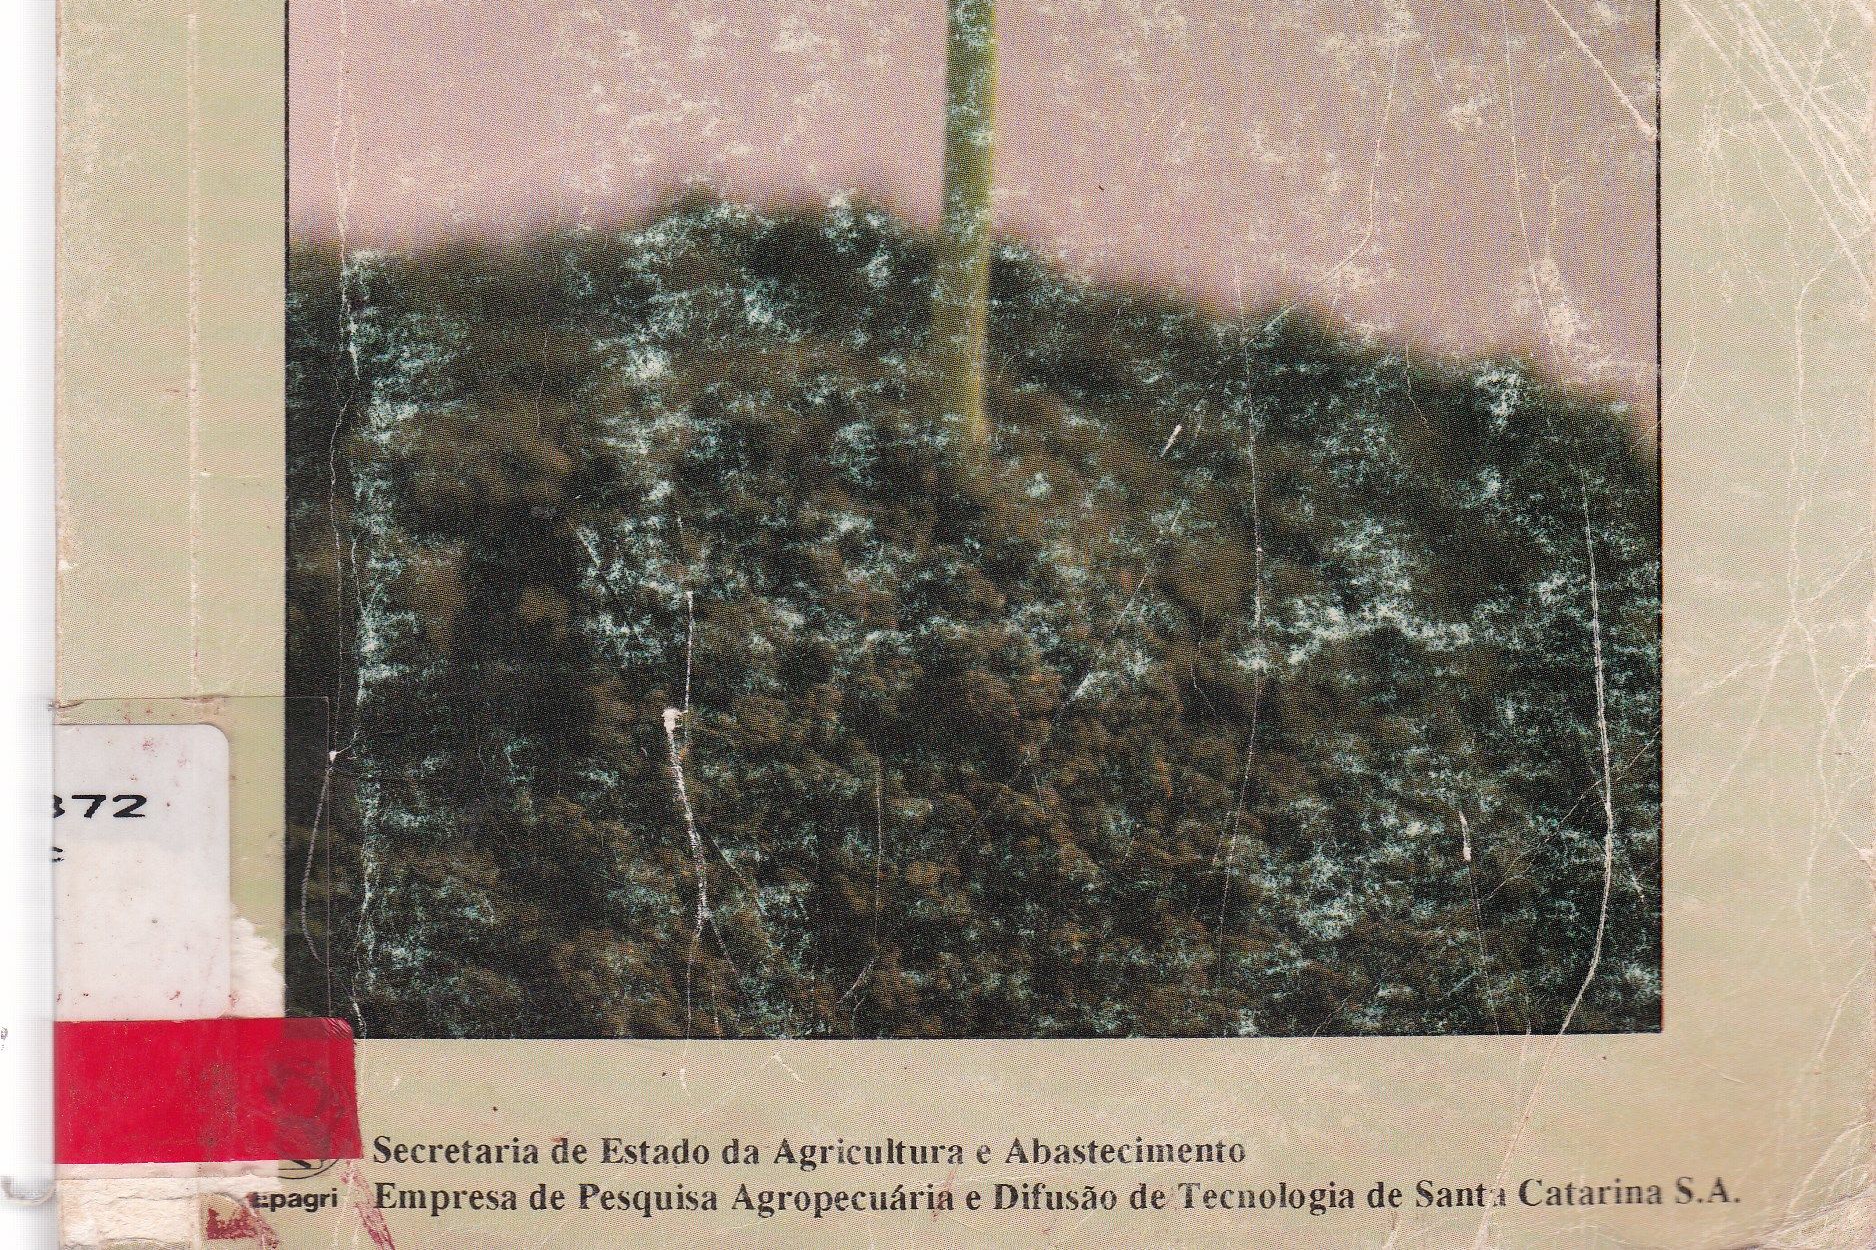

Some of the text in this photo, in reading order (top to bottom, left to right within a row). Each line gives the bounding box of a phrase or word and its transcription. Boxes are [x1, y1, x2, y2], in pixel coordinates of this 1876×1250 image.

[373, 1134, 1247, 1172] Secretaria de Estado da Agricultura e Abastecimento
[374, 1181, 518, 1217] Empresa
[529, 1182, 566, 1211] de
[577, 1183, 718, 1218] Pesquisa
[731, 1182, 953, 1219] Agropecuária
[965, 1189, 982, 1211] e
[993, 1181, 1118, 1211] Difusão
[1129, 1182, 1166, 1210] de
[1177, 1181, 1355, 1217] Tecnologia
[1366, 1181, 1404, 1209] de
[1518, 1177, 1663, 1208] Catarina
[1674, 1175, 1742, 1205] S.A.
